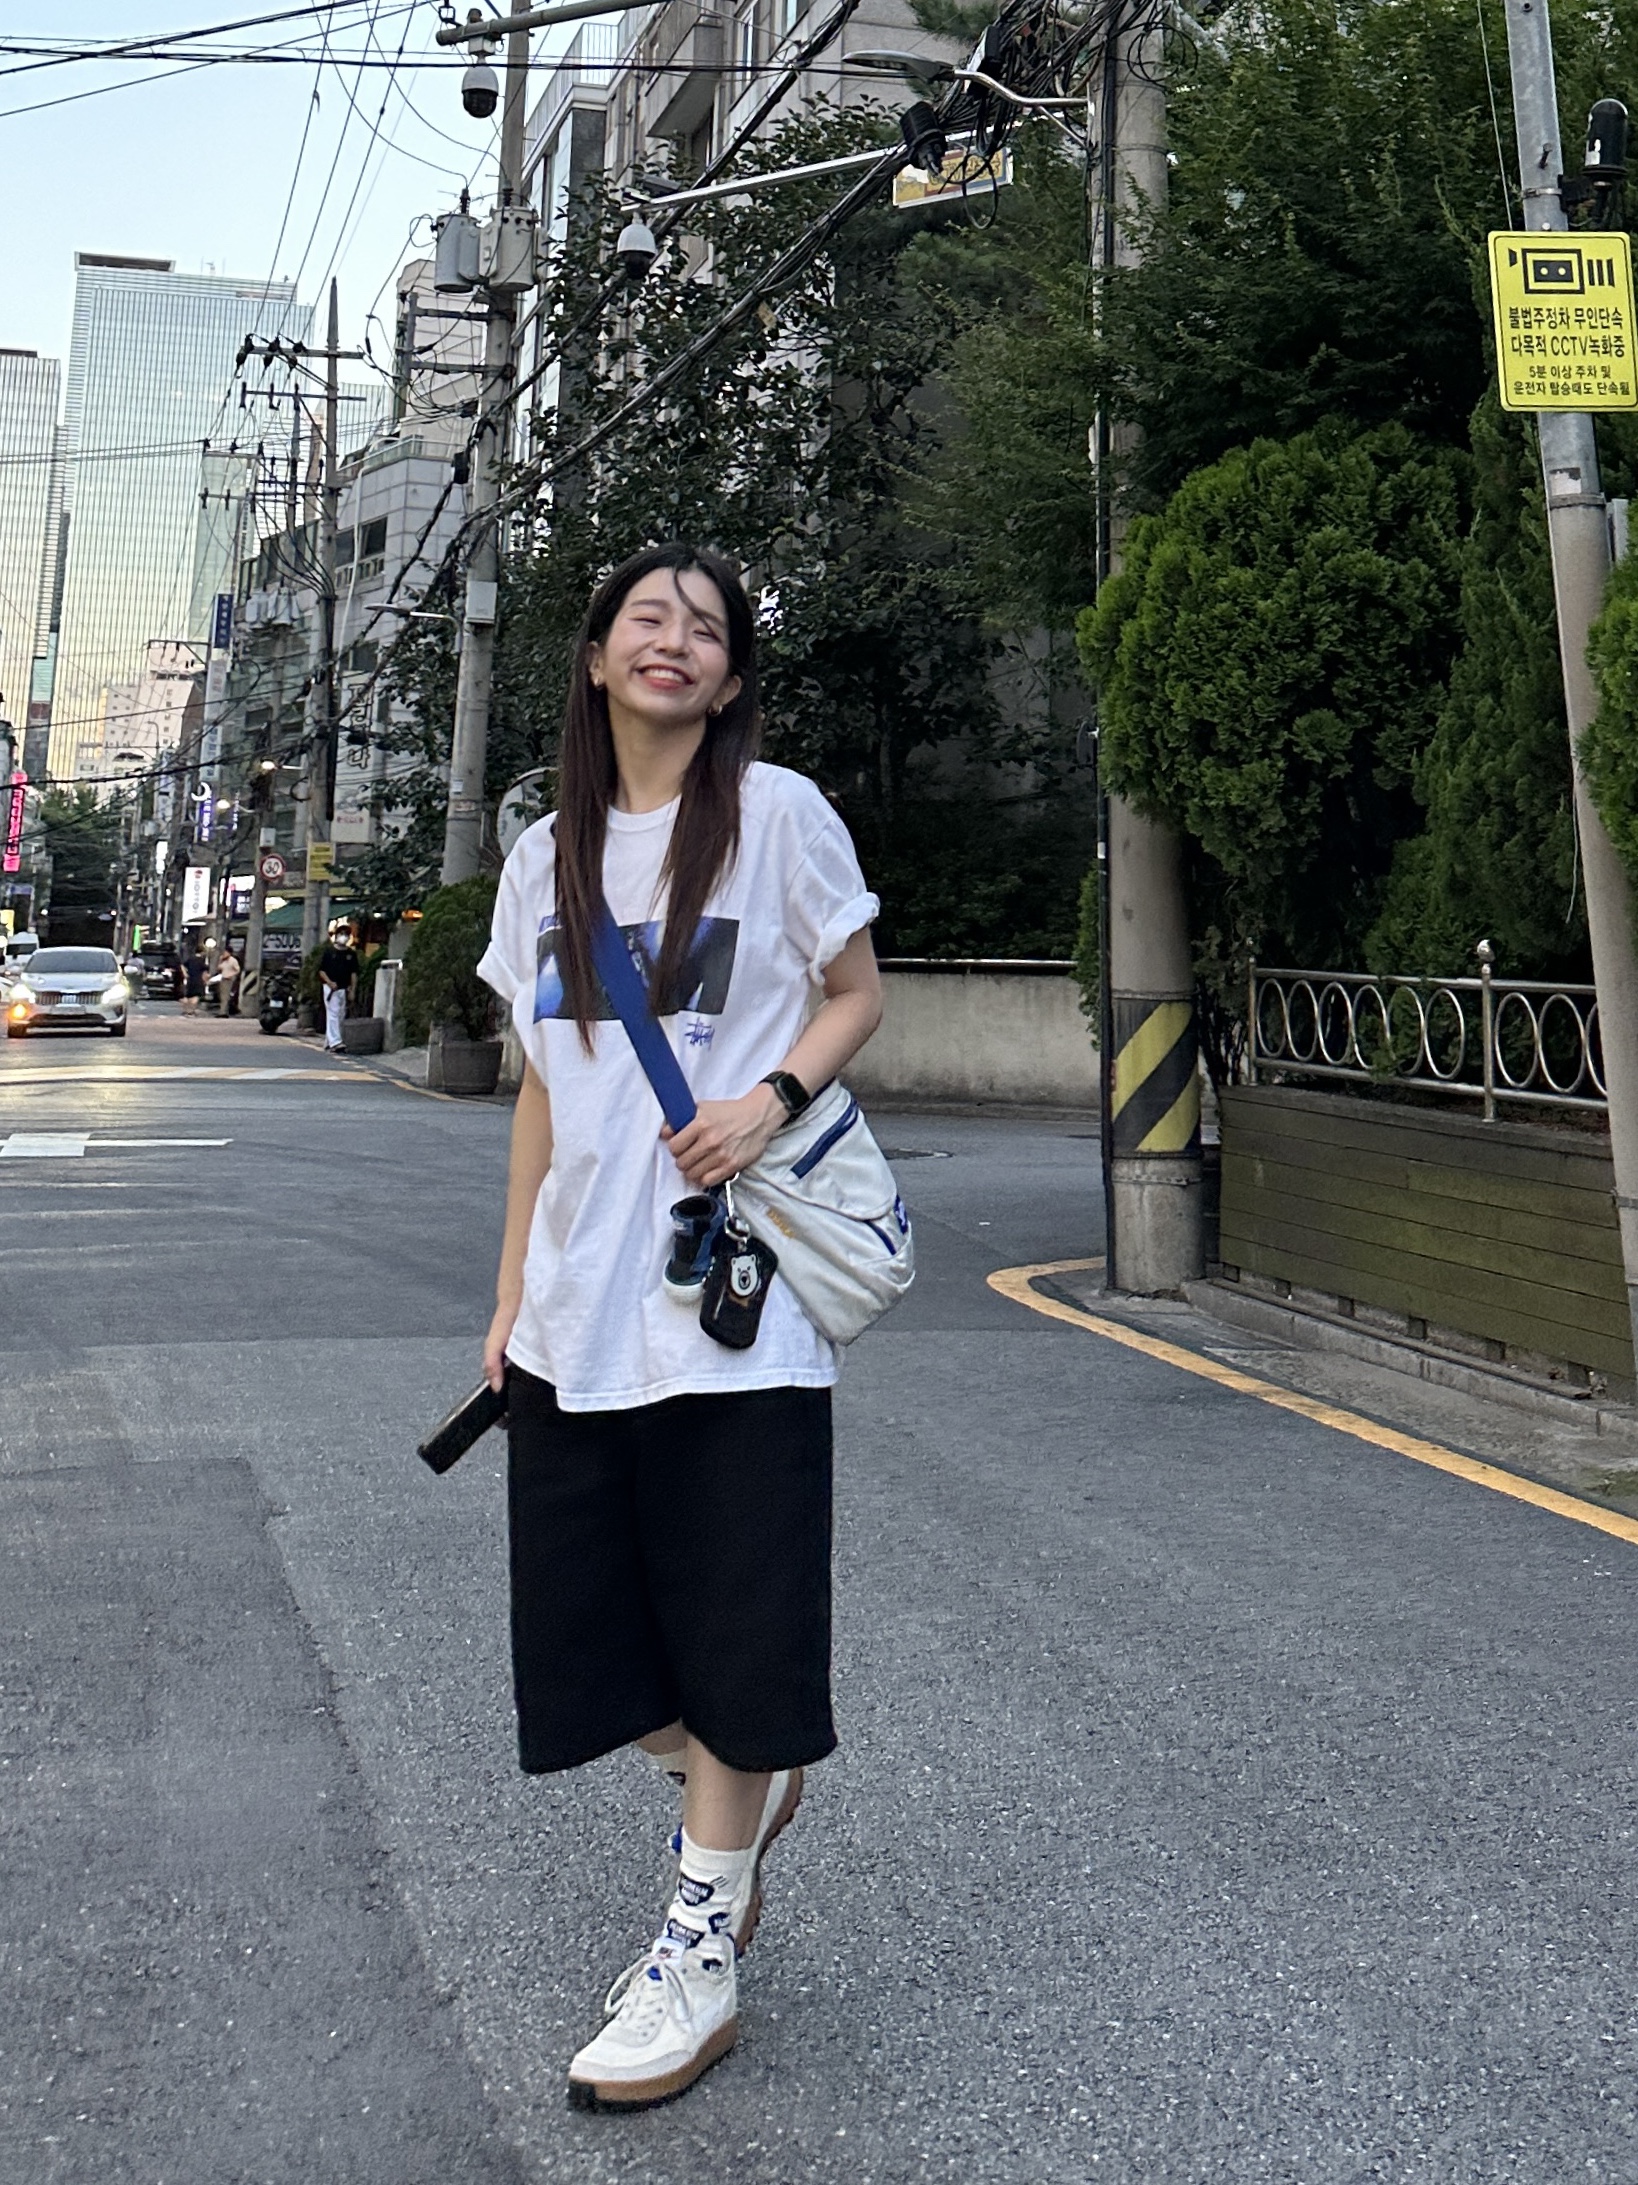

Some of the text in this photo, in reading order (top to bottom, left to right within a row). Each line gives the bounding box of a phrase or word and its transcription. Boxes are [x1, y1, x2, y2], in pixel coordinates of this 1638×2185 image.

[1509, 306, 1623, 330] 불법주정차 무인단속
[1511, 335, 1547, 357] 다목적
[1529, 365, 1611, 379] 5분 이상 주차 및
[1513, 381, 1546, 395] 운전자
[265, 861, 279, 875] 30
